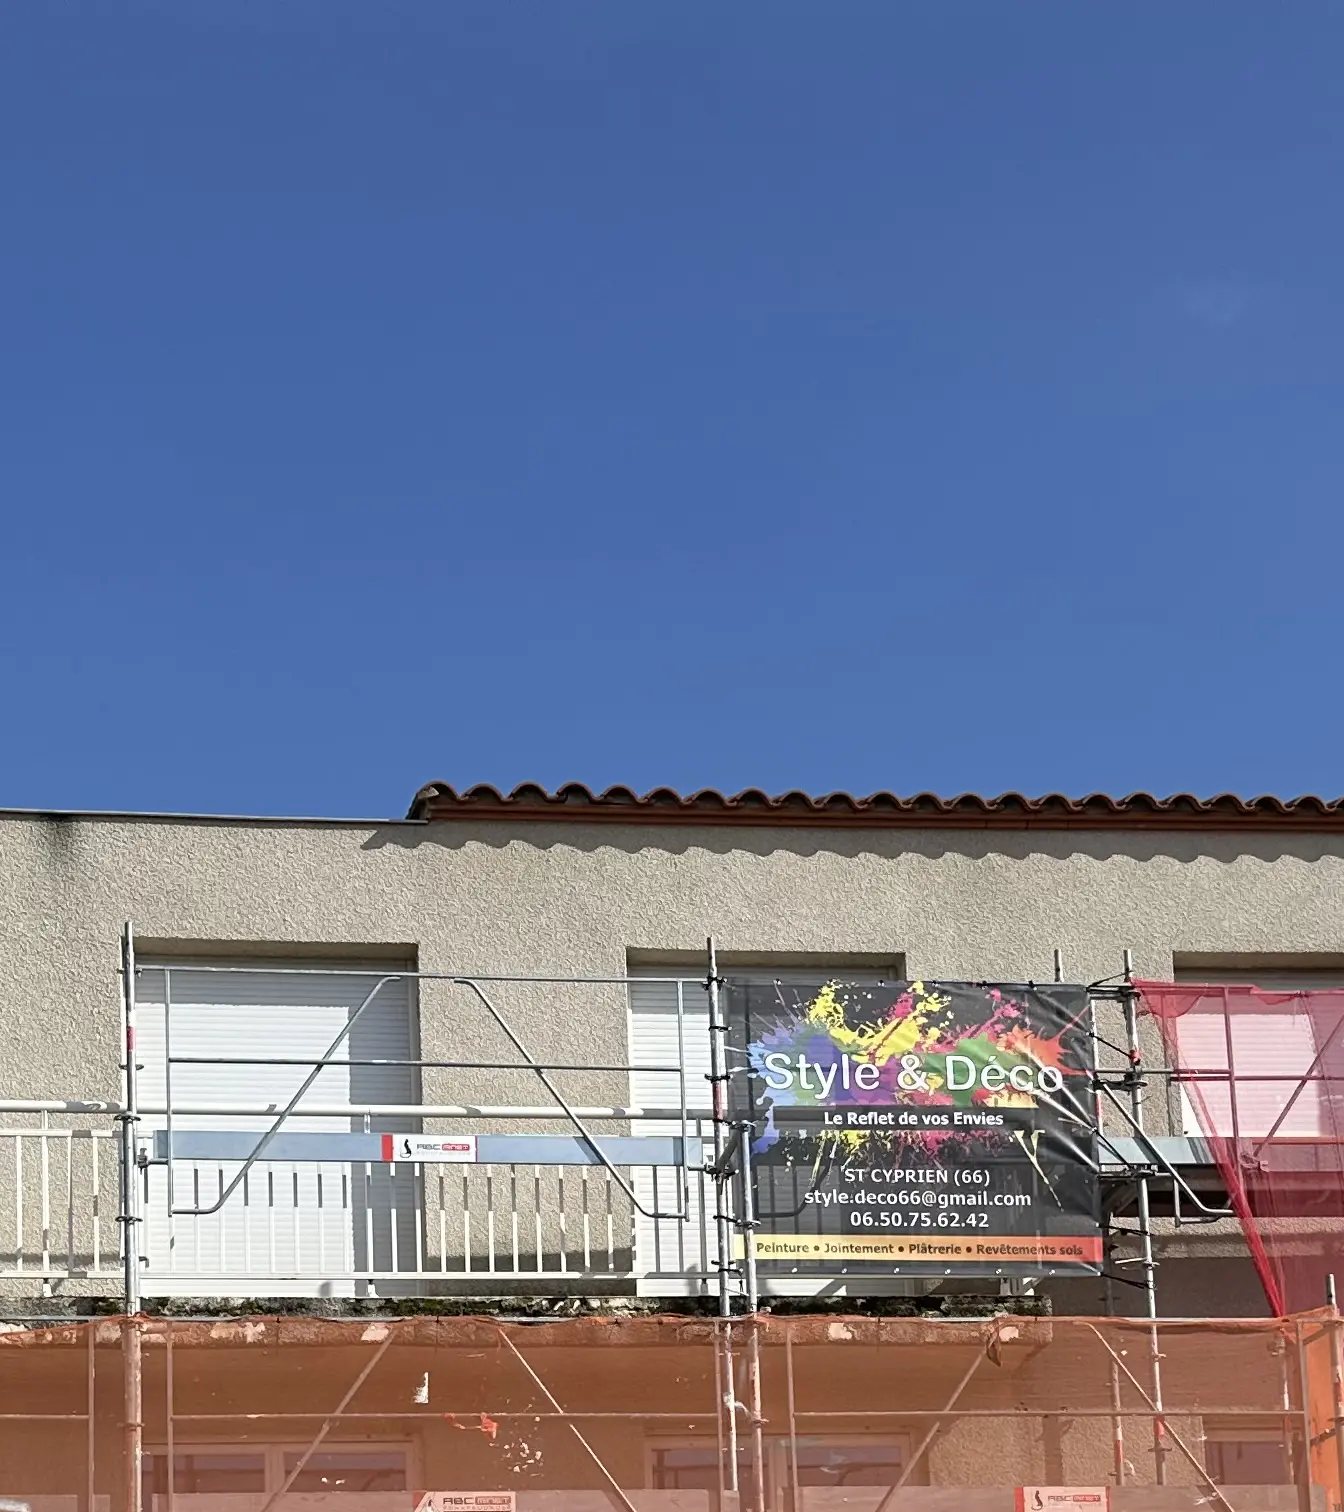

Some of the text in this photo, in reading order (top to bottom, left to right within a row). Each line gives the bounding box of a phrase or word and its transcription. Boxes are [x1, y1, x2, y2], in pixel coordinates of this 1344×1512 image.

[764, 1053, 1063, 1100] Style & Déco
[824, 1111, 1004, 1126] Le Reflet de vos Envies
[844, 1168, 991, 1186] ST CYPRIEN (66)
[804, 1189, 1032, 1208] style.deco66@gmail.com
[850, 1211, 990, 1228] 06.50.75.62.42
[757, 1242, 1083, 1256] Peinture Jointement Plâtrerie Revêtements sols
